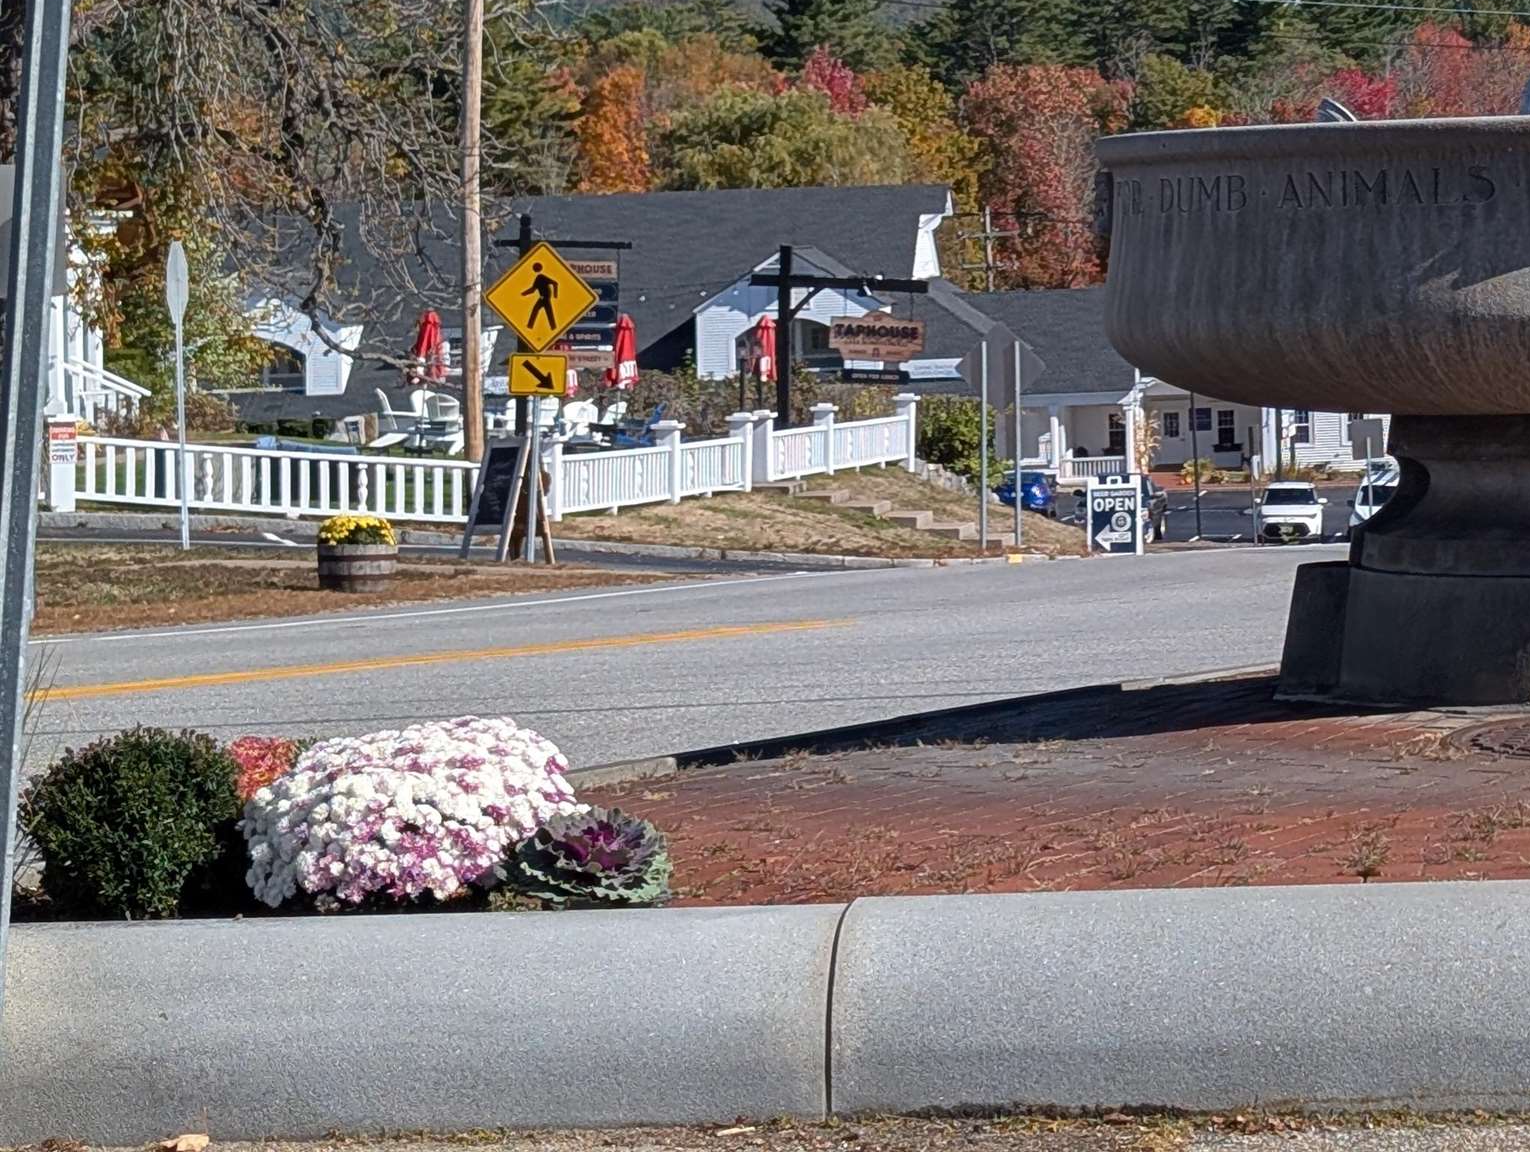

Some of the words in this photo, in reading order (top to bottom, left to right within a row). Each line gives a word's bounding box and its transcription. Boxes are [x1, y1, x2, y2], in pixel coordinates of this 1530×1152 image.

[1159, 174, 1248, 214] DUMB
[1276, 165, 1496, 209] ANIMALS
[834, 323, 919, 340] TAPHOUSE
[52, 454, 75, 462] ONLY
[1093, 497, 1135, 512] OPEN
